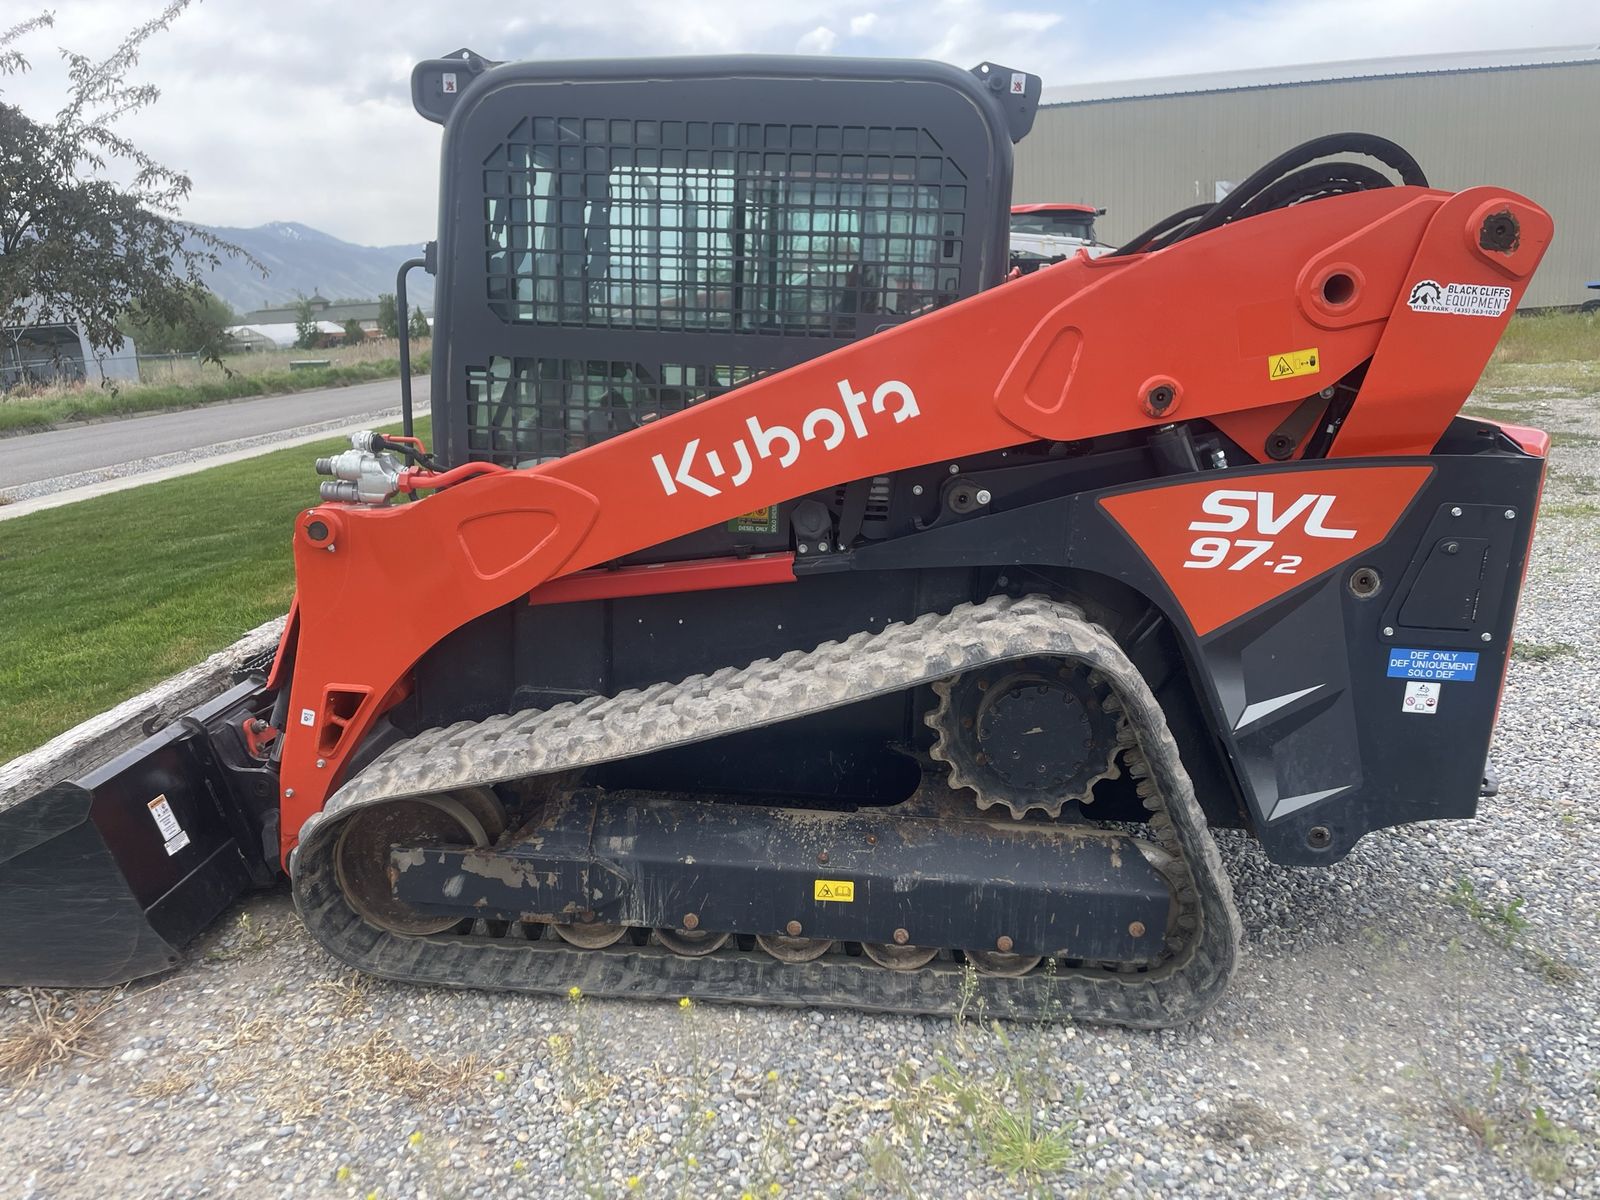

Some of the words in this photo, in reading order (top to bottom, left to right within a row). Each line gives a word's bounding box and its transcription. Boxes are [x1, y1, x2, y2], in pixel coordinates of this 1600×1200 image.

[1448, 284, 1478, 295] BLACK
[1479, 286, 1511, 298] CLIFFS
[1445, 294, 1510, 310] EQUIPMENT
[651, 379, 921, 498] Kubota
[1187, 489, 1358, 539] SVL
[1183, 536, 1303, 574] 97-2
[1410, 651, 1430, 660] DEF
[1432, 652, 1458, 661] ONLY
[1390, 659, 1410, 667] DEF
[1412, 660, 1476, 671] UNIQUEMENT
[1407, 669, 1433, 677] SOLO
[1435, 670, 1456, 679] DEF
